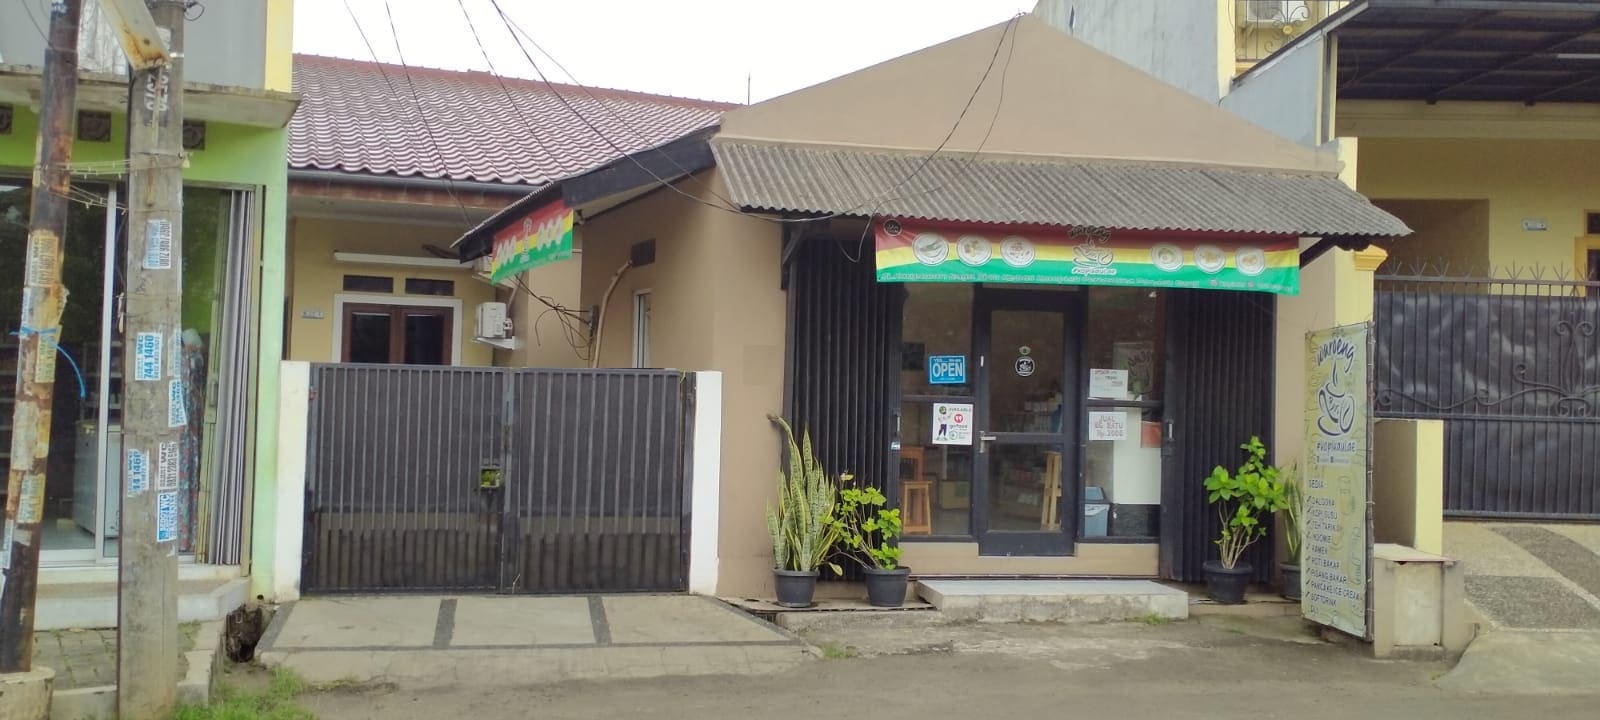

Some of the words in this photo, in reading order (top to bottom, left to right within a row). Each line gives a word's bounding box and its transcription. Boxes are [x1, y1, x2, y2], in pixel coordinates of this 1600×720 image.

[144, 335, 155, 359] 1460
[1317, 338, 1354, 374] waroeng
[144, 362, 154, 379] 744
[932, 362, 963, 378] OPEN
[1311, 581, 1333, 594] PANCAKE
